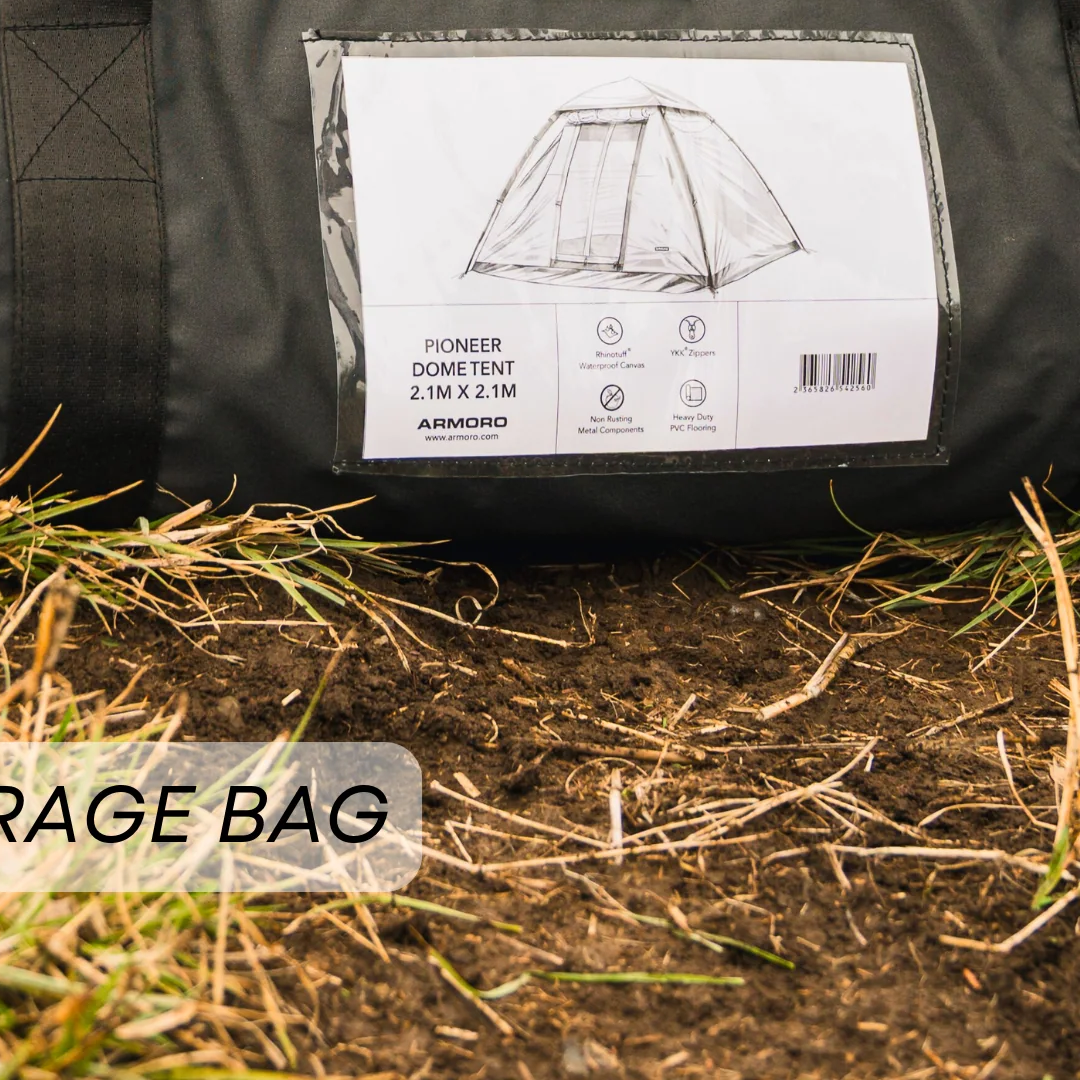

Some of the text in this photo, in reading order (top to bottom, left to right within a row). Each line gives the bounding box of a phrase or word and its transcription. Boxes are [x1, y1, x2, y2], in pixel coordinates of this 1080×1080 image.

[424, 337, 502, 353] PIONEER
[688, 349, 716, 358] Zippers
[412, 360, 515, 377] DOME TENT
[579, 361, 645, 371] Waterproof Canvas
[410, 383, 516, 400] 2.1M X 2.1M
[607, 415, 633, 424] Rusting
[672, 413, 714, 422] Heavy Duty
[417, 416, 508, 430] ARMORO
[599, 426, 645, 435] Components
[686, 424, 717, 433] Flooring
[424, 433, 499, 441] www.armoro.com
